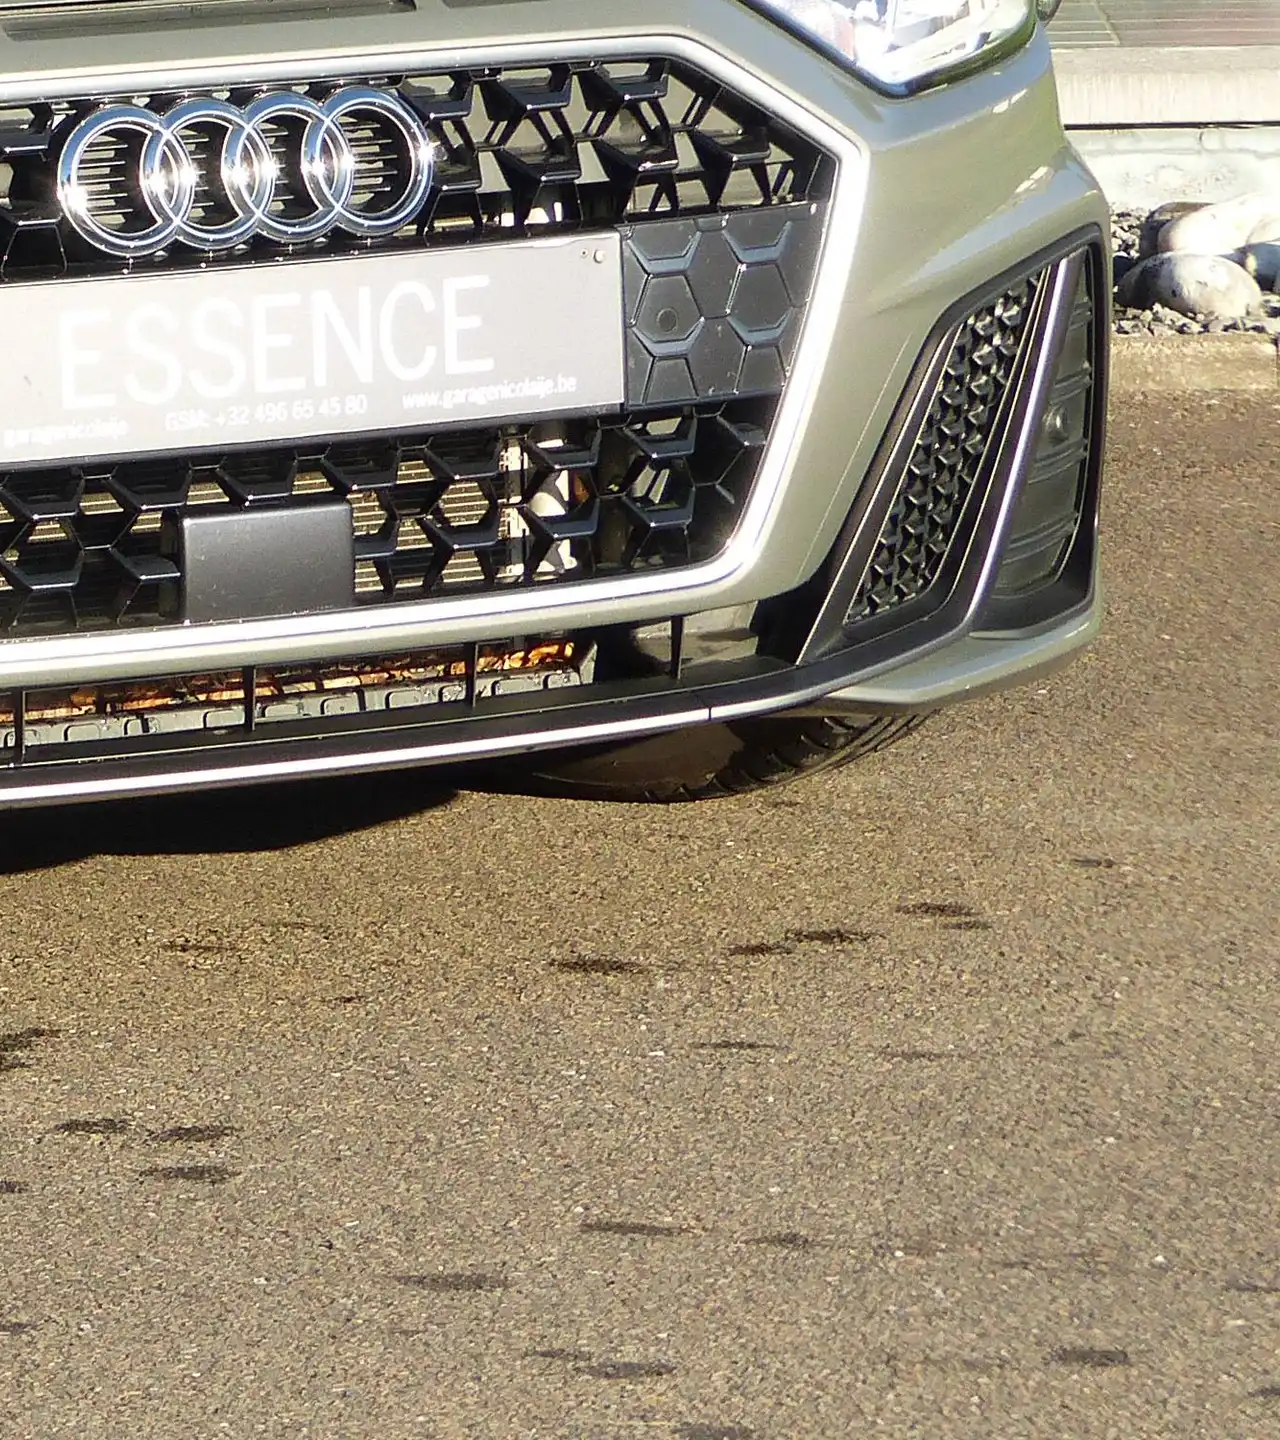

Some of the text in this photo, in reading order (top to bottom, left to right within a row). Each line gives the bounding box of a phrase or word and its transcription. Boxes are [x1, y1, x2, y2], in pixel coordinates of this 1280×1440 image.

[57, 274, 496, 411] ESSENCE
[214, 405, 250, 427] +32
[254, 401, 288, 423] 496
[291, 398, 315, 421] 65
[318, 396, 341, 418] 45
[344, 393, 368, 416] 80
